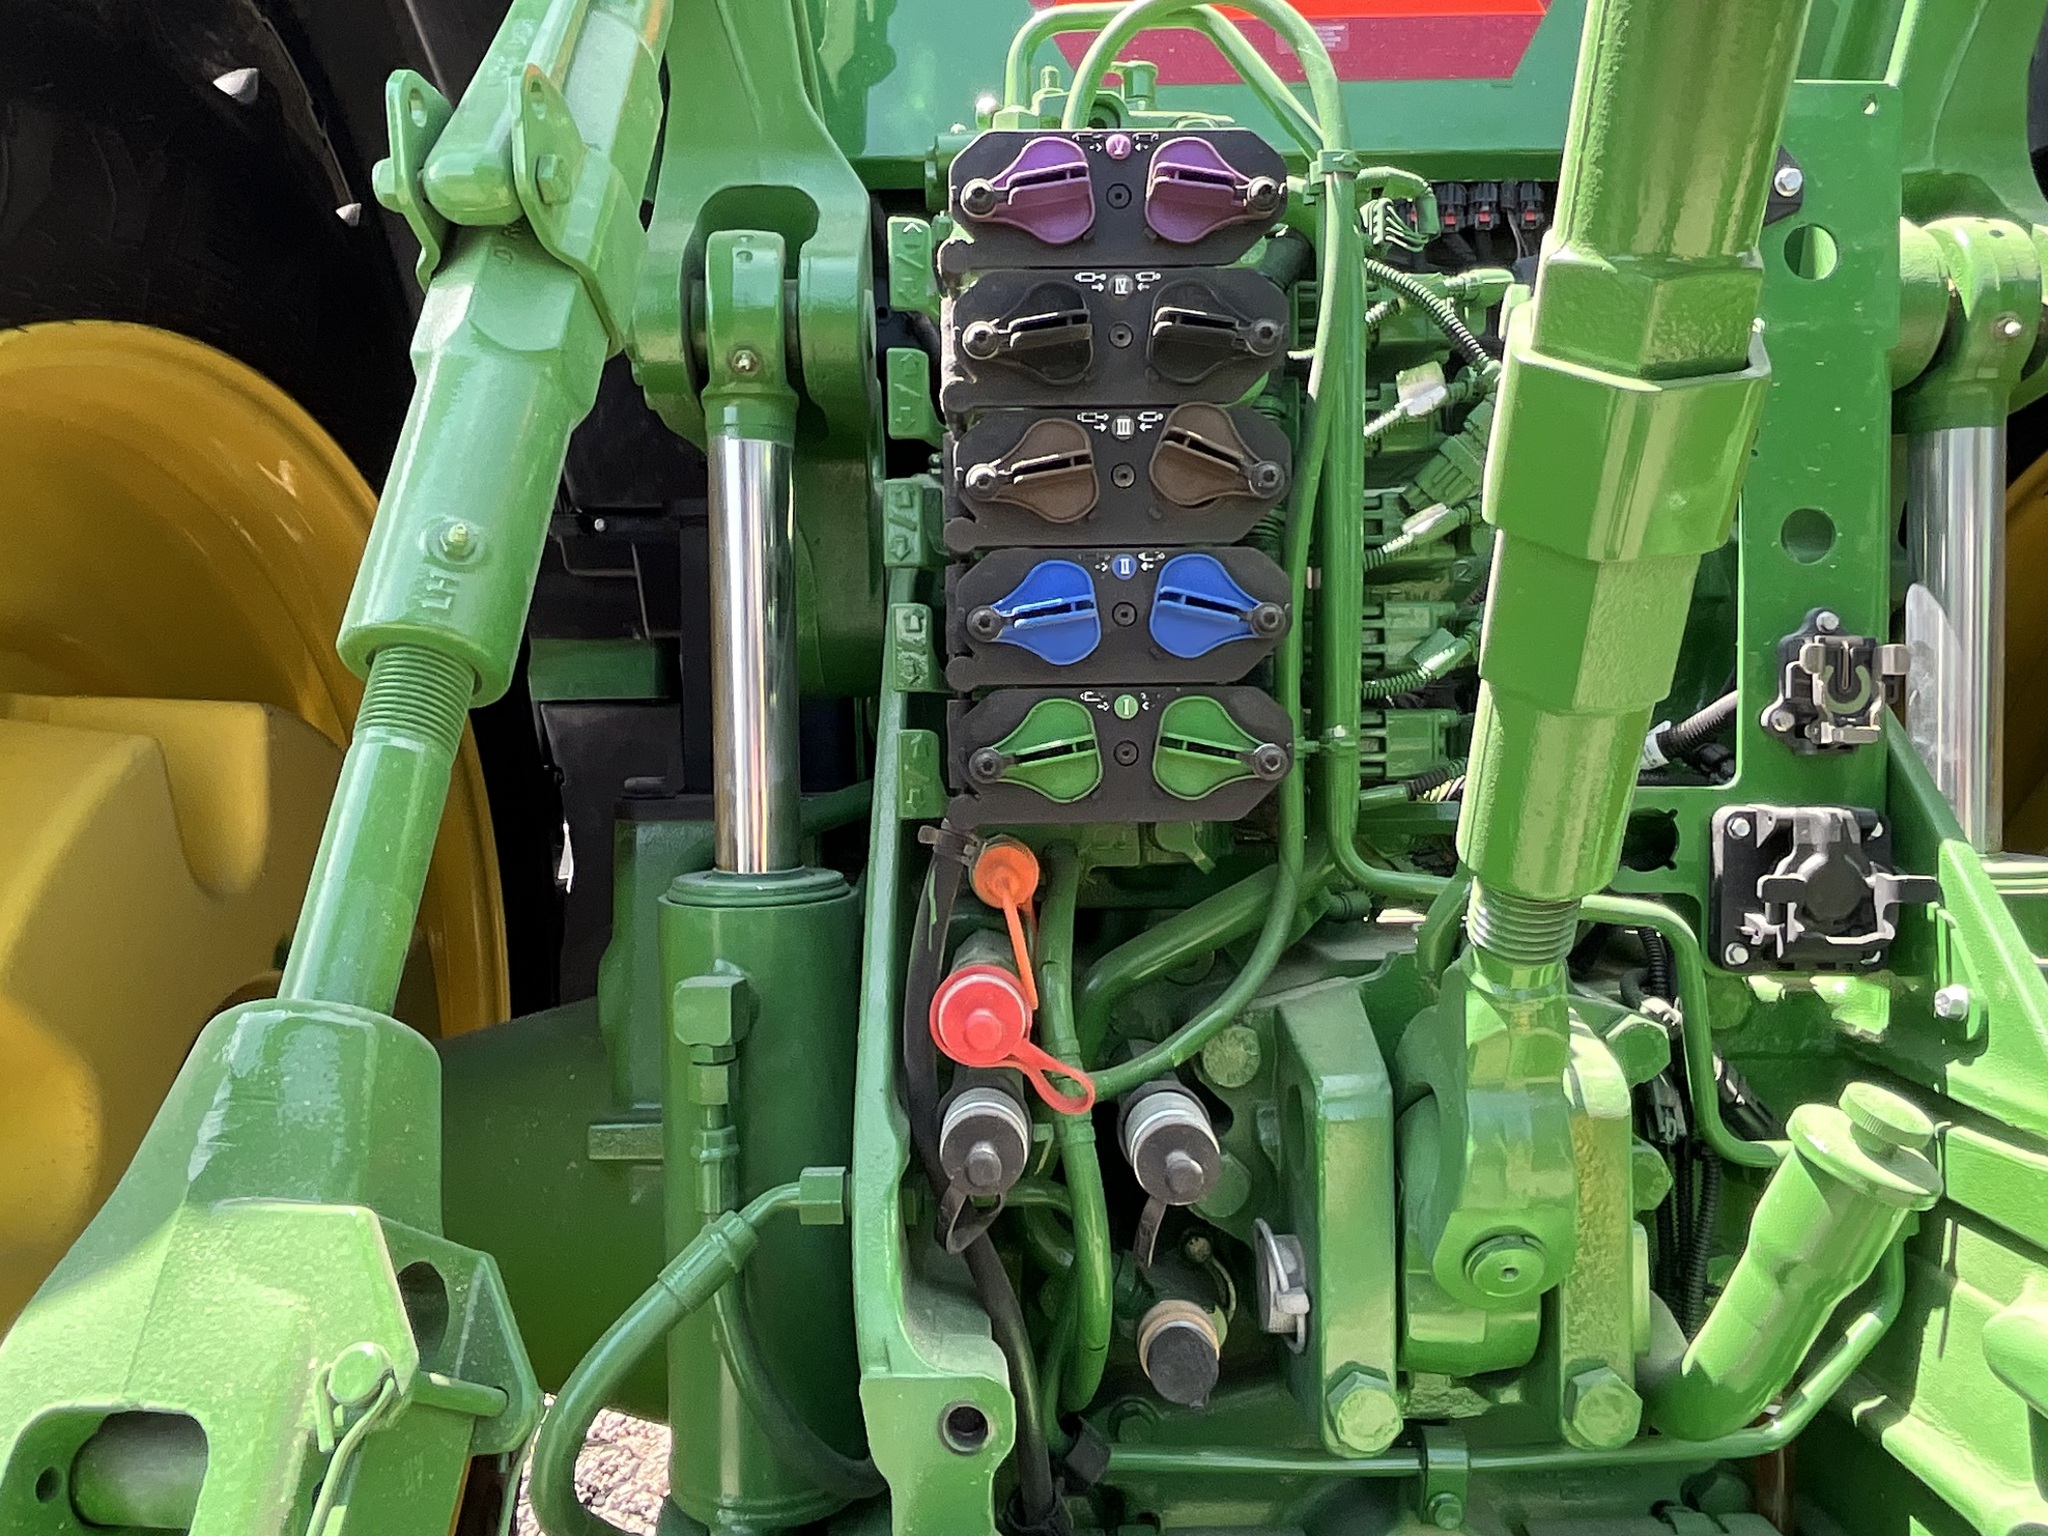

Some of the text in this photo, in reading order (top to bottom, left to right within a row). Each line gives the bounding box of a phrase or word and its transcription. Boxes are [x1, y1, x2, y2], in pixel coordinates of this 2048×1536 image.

[1111, 138, 1128, 155] V
[1114, 277, 1129, 294] IV
[1115, 418, 1131, 435] III
[1119, 557, 1131, 575] II
[1123, 698, 1130, 716] I
